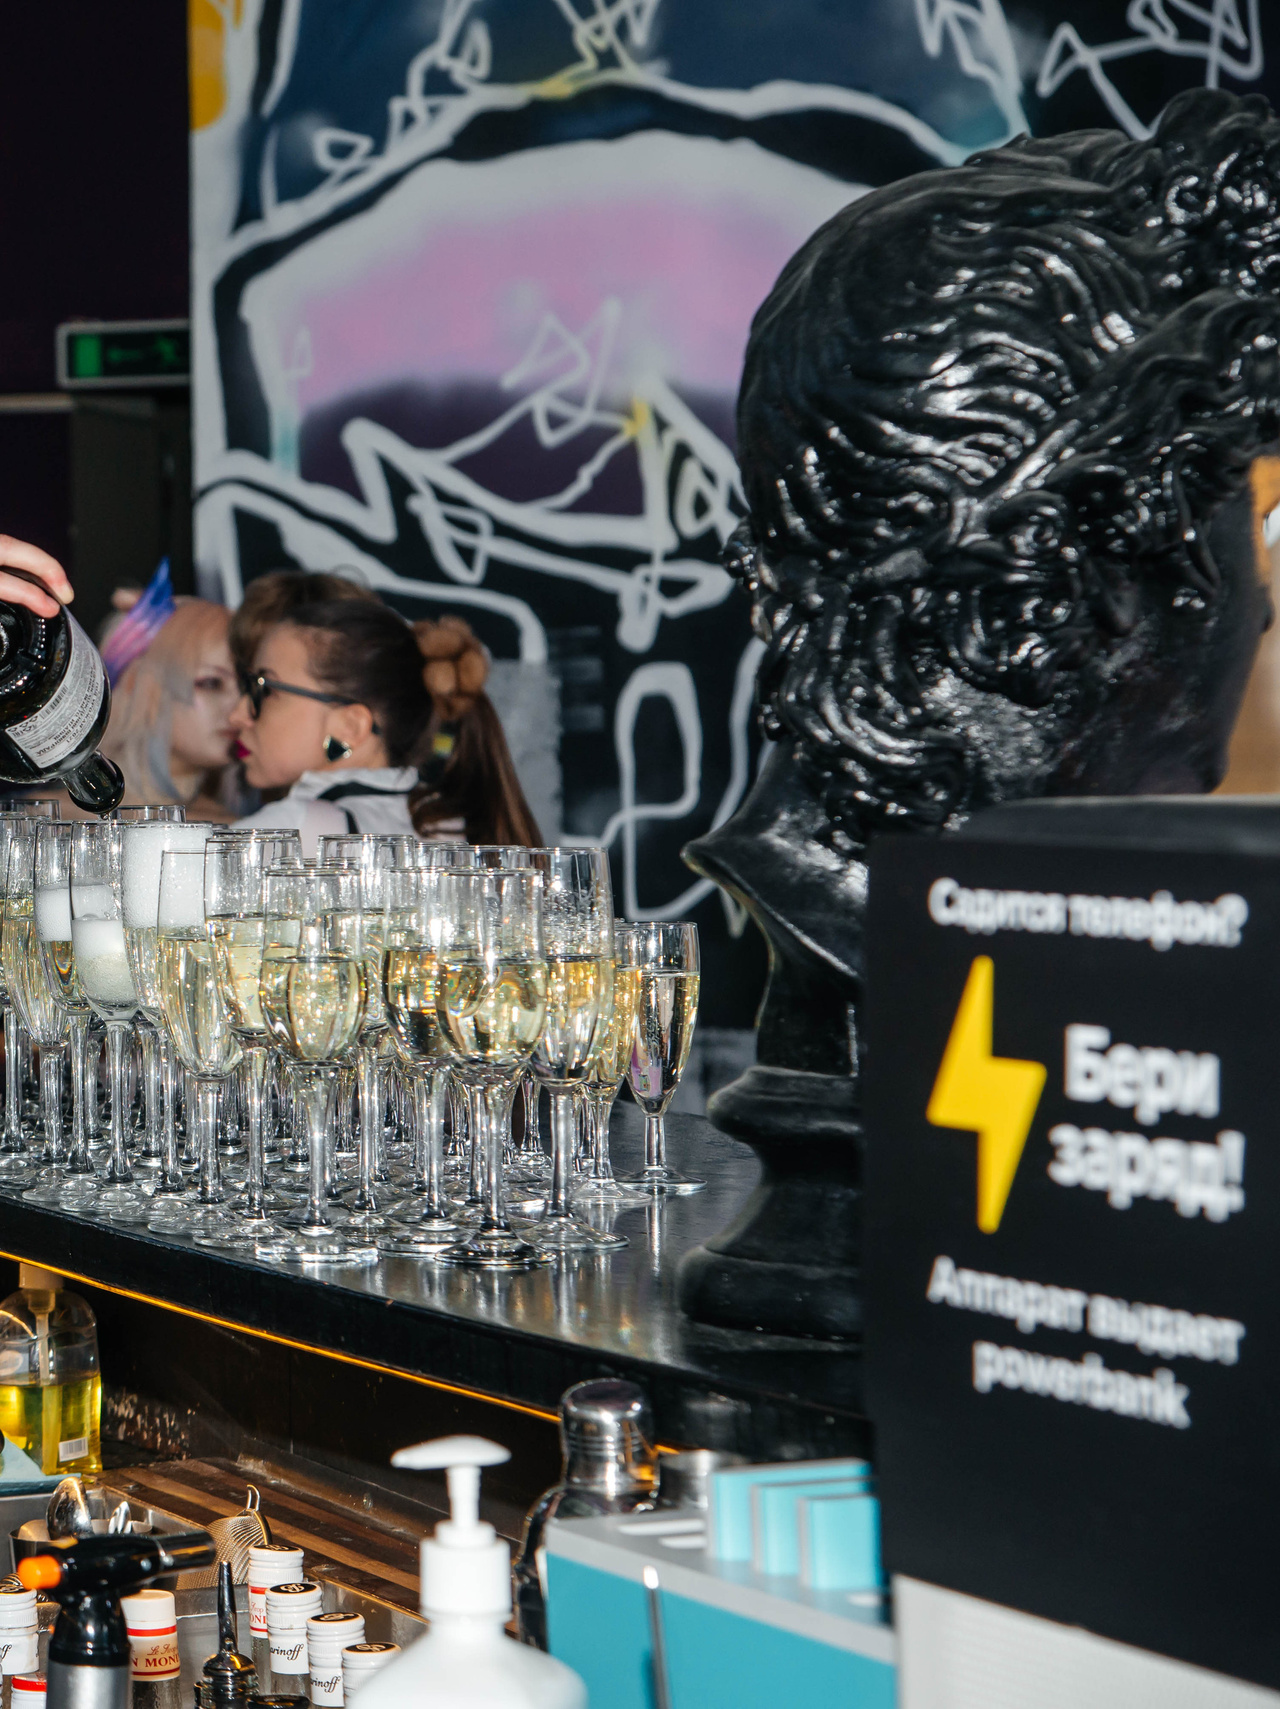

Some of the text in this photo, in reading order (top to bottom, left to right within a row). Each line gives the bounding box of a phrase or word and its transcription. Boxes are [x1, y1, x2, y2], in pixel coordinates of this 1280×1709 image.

[1068, 889, 1249, 951] телефон?
[1064, 1023, 1221, 1125] Бери
[1047, 1123, 1247, 1222] заряд!
[926, 1255, 1089, 1334] Аппарат
[973, 1340, 1191, 1429] powerbank
